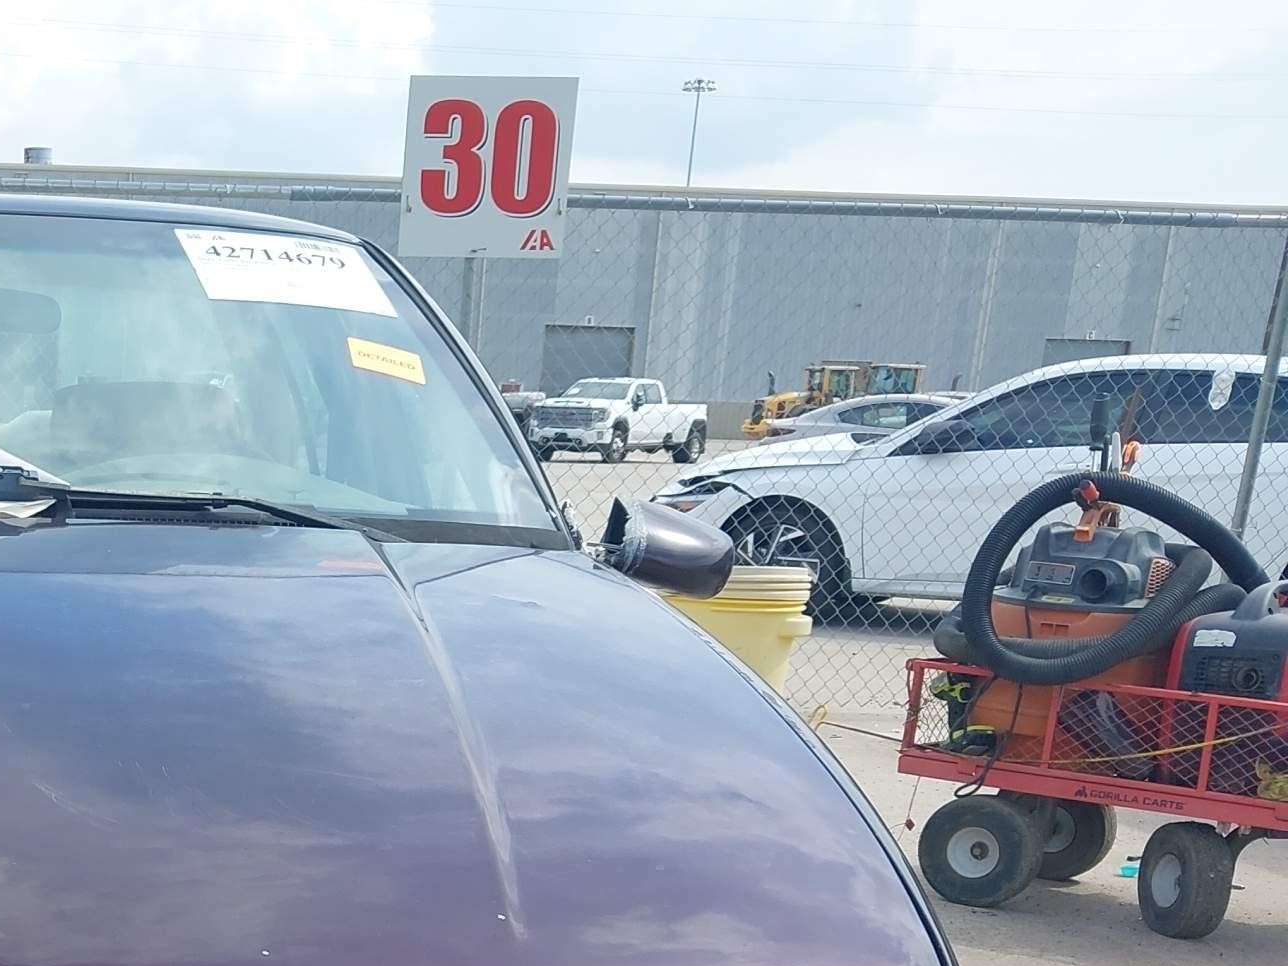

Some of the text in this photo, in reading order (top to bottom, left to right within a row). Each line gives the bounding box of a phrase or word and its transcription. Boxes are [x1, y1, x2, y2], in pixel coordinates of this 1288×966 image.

[418, 97, 560, 217] 30
[205, 244, 346, 269] 42714679
[357, 350, 416, 370] DETAILED
[1089, 789, 1185, 810] GORILLA CARTS
